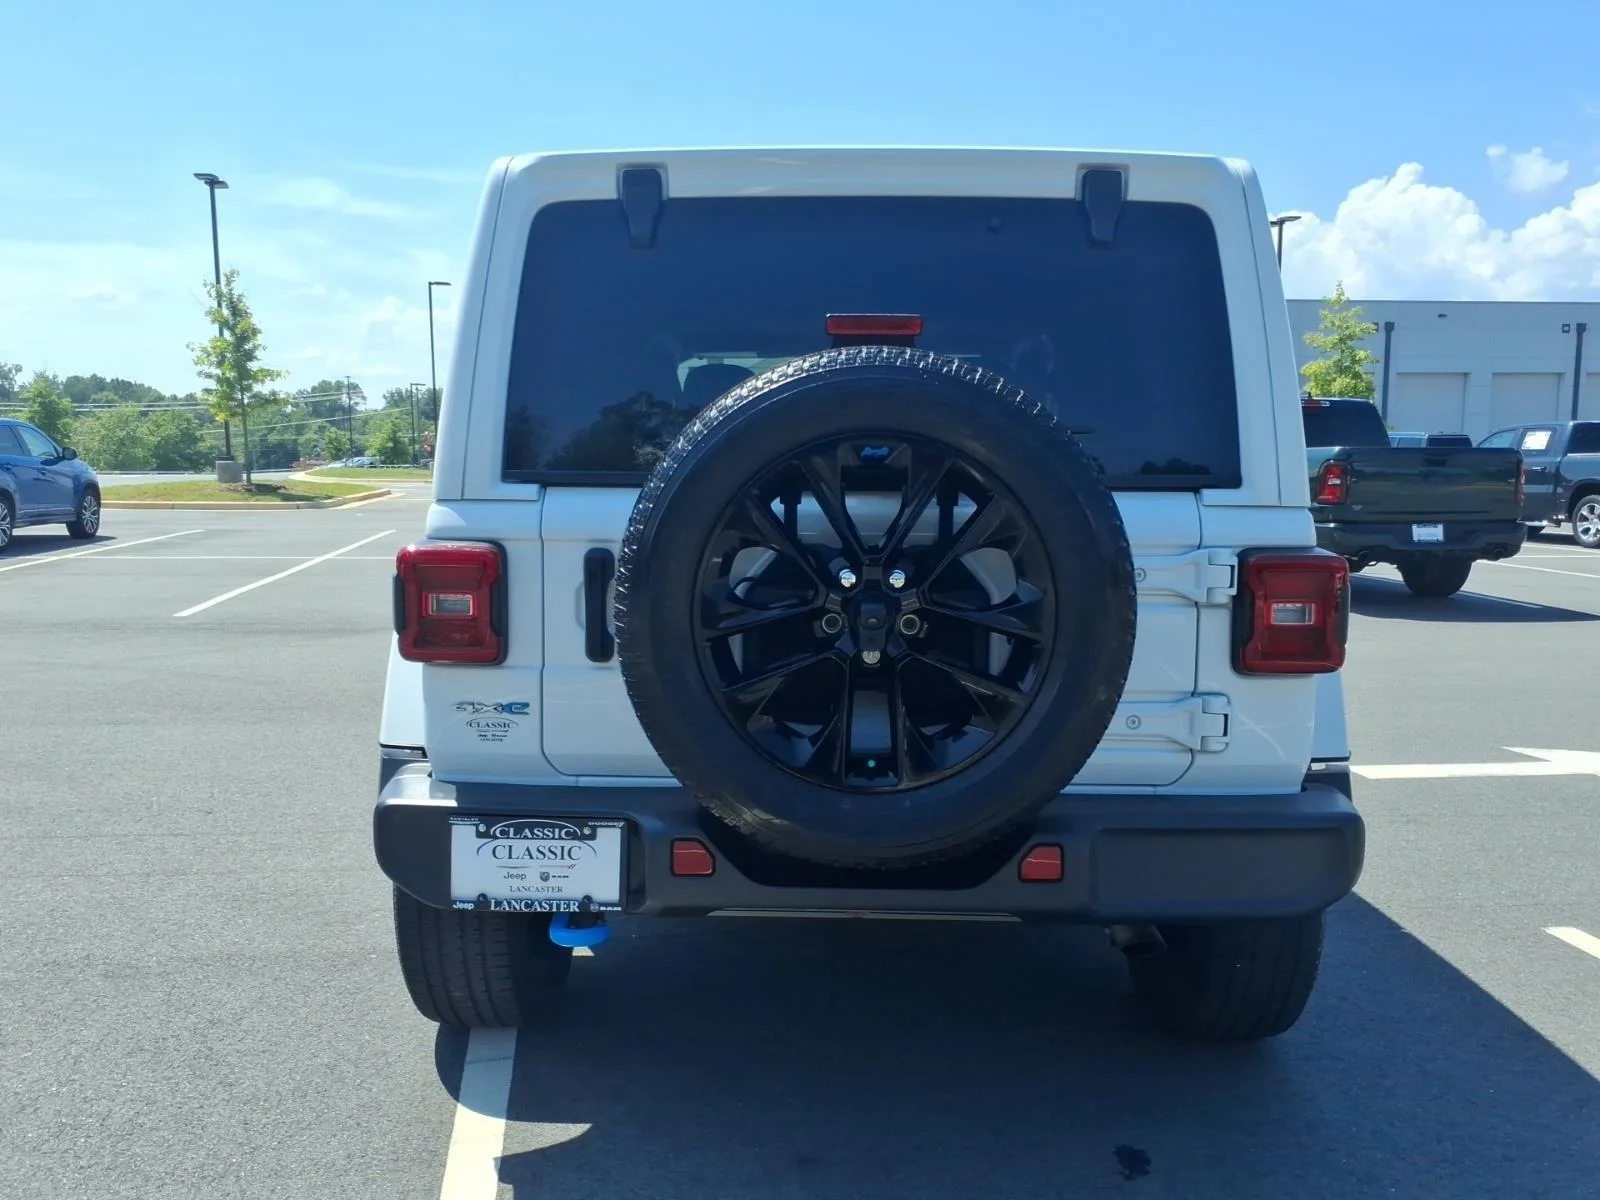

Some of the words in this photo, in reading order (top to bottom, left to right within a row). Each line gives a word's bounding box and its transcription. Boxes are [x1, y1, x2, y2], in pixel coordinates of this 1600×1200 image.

[469, 721, 514, 729] CLASSIC
[495, 826, 574, 839] CLASSIC
[492, 844, 582, 861] CLASSIC
[503, 872, 527, 880] Jeep
[509, 885, 563, 893] LANCASTER
[452, 901, 475, 910] Jeep
[490, 899, 580, 912] LANCASTER
